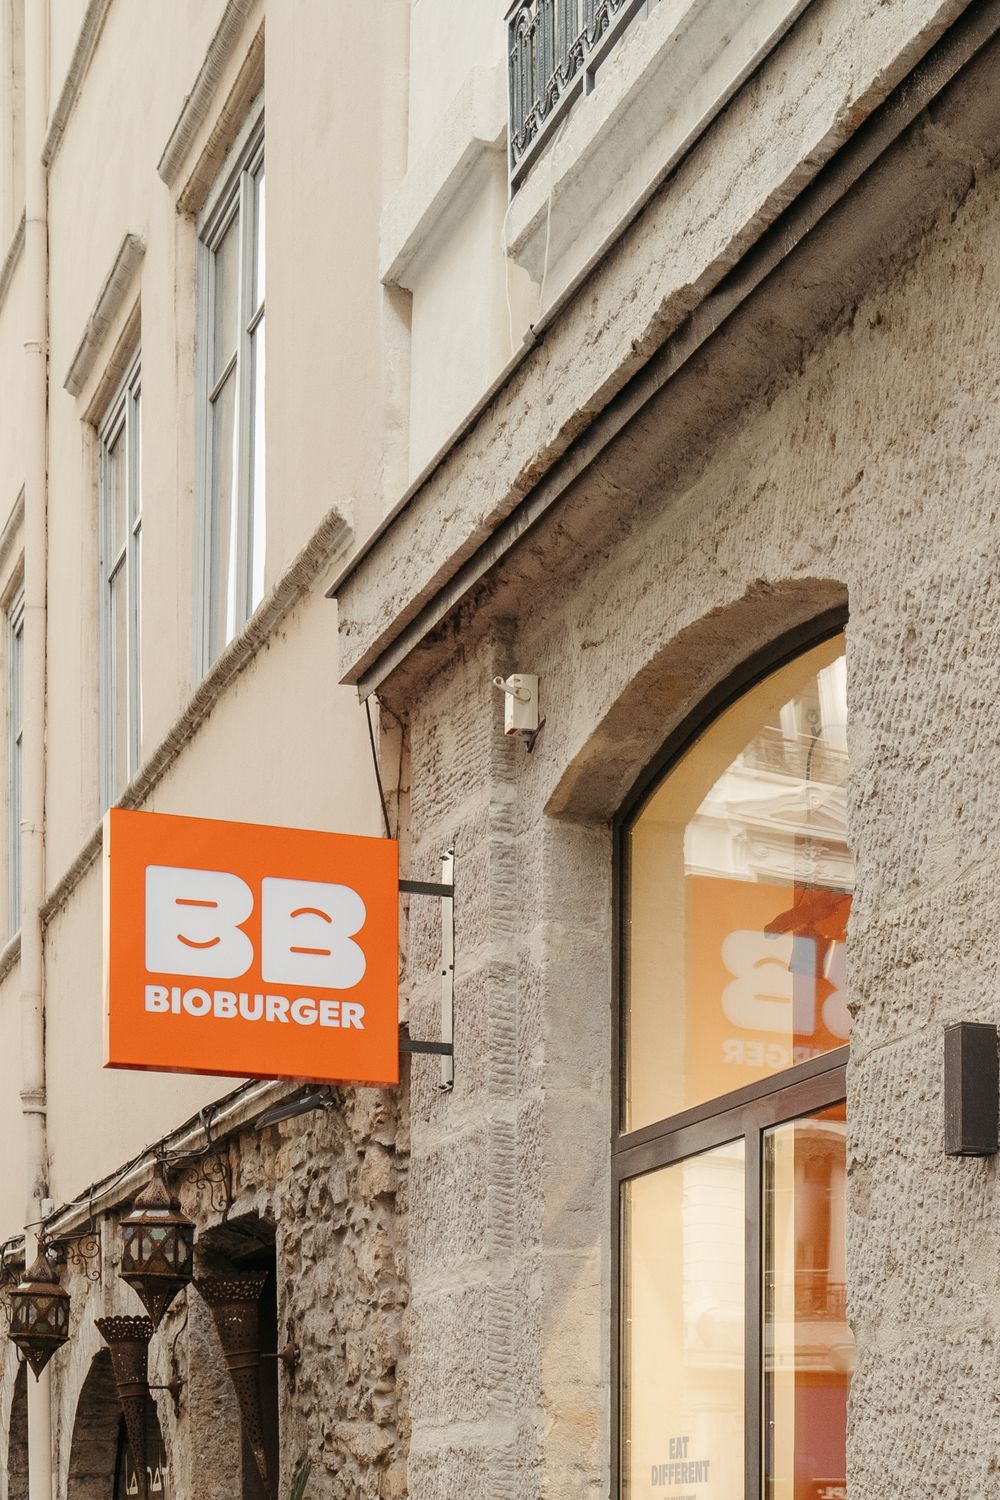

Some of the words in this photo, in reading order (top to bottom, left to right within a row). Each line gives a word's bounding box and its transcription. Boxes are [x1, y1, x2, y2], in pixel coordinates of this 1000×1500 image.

[145, 864, 367, 990] BB
[144, 984, 366, 1030] BIOBURGER
[669, 1436, 690, 1460] EAT
[651, 1460, 710, 1486] DIFFERENT
